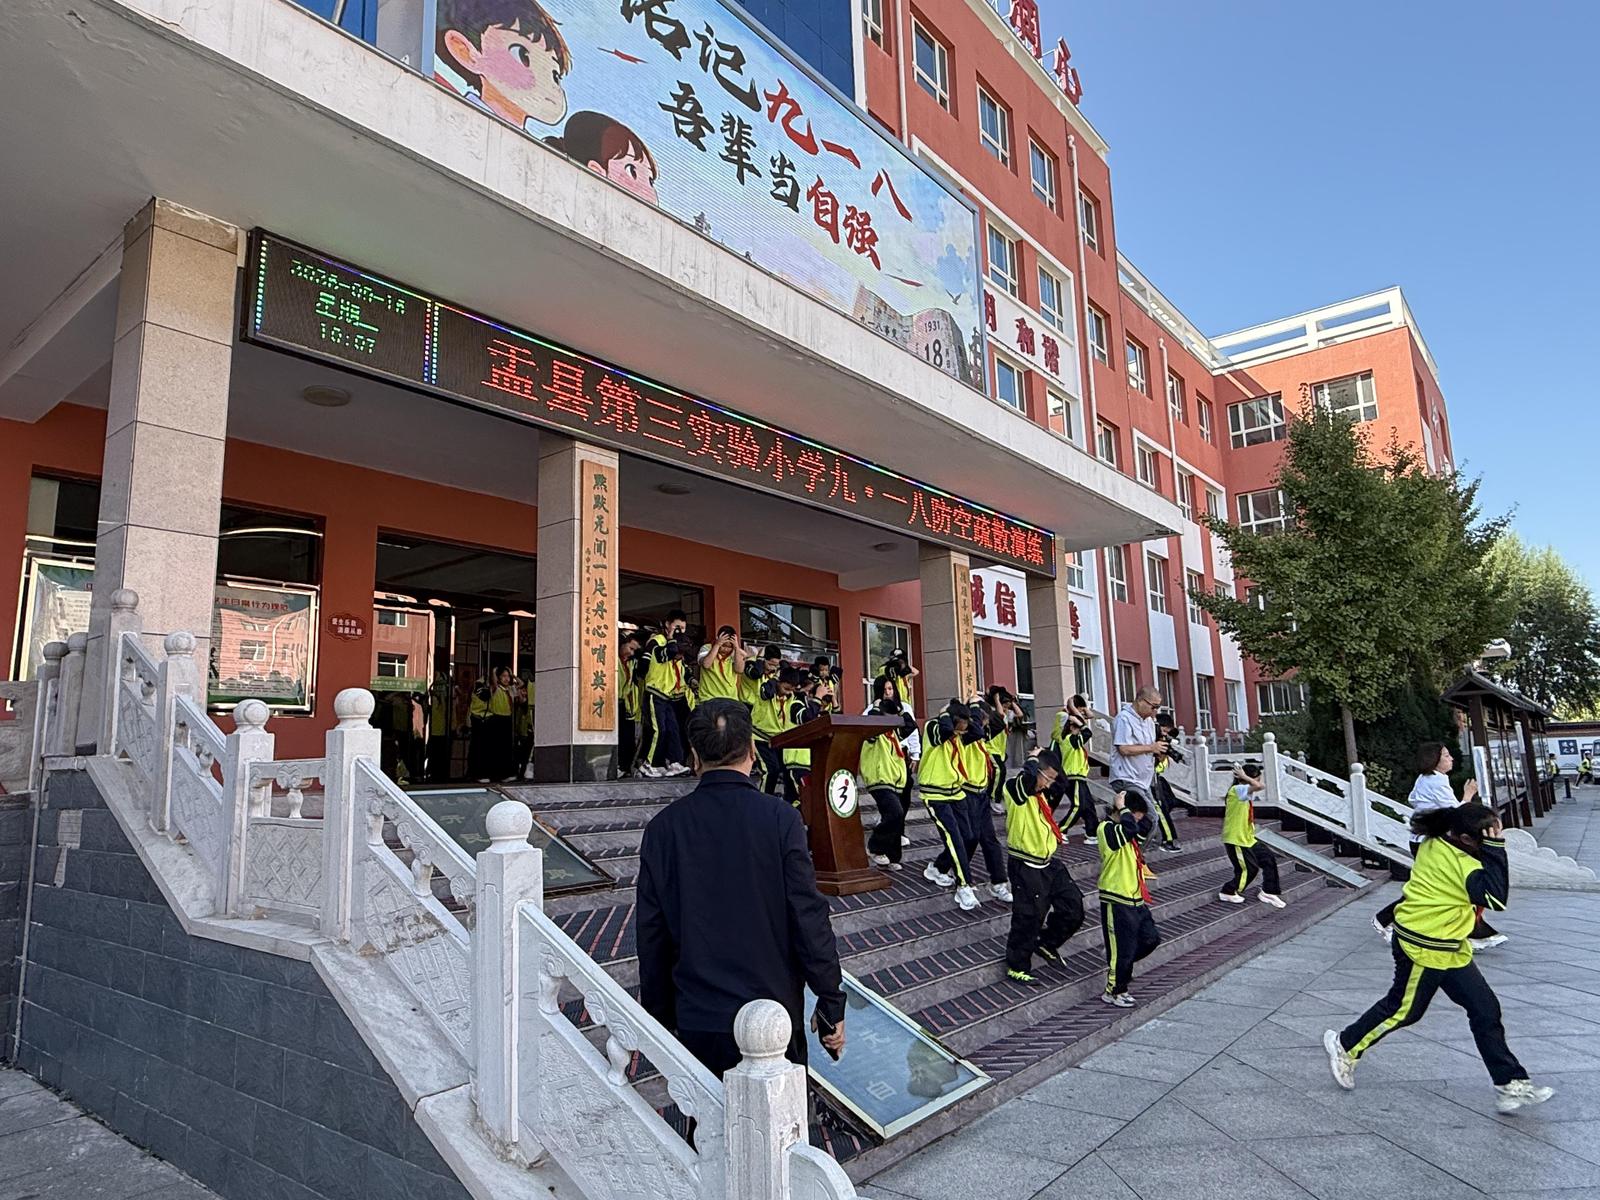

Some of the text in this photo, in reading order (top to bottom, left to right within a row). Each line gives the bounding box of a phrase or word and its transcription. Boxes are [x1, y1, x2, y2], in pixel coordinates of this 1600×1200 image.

[658, 79, 882, 271] 吾辈当自强
[320, 321, 376, 354] 10:07
